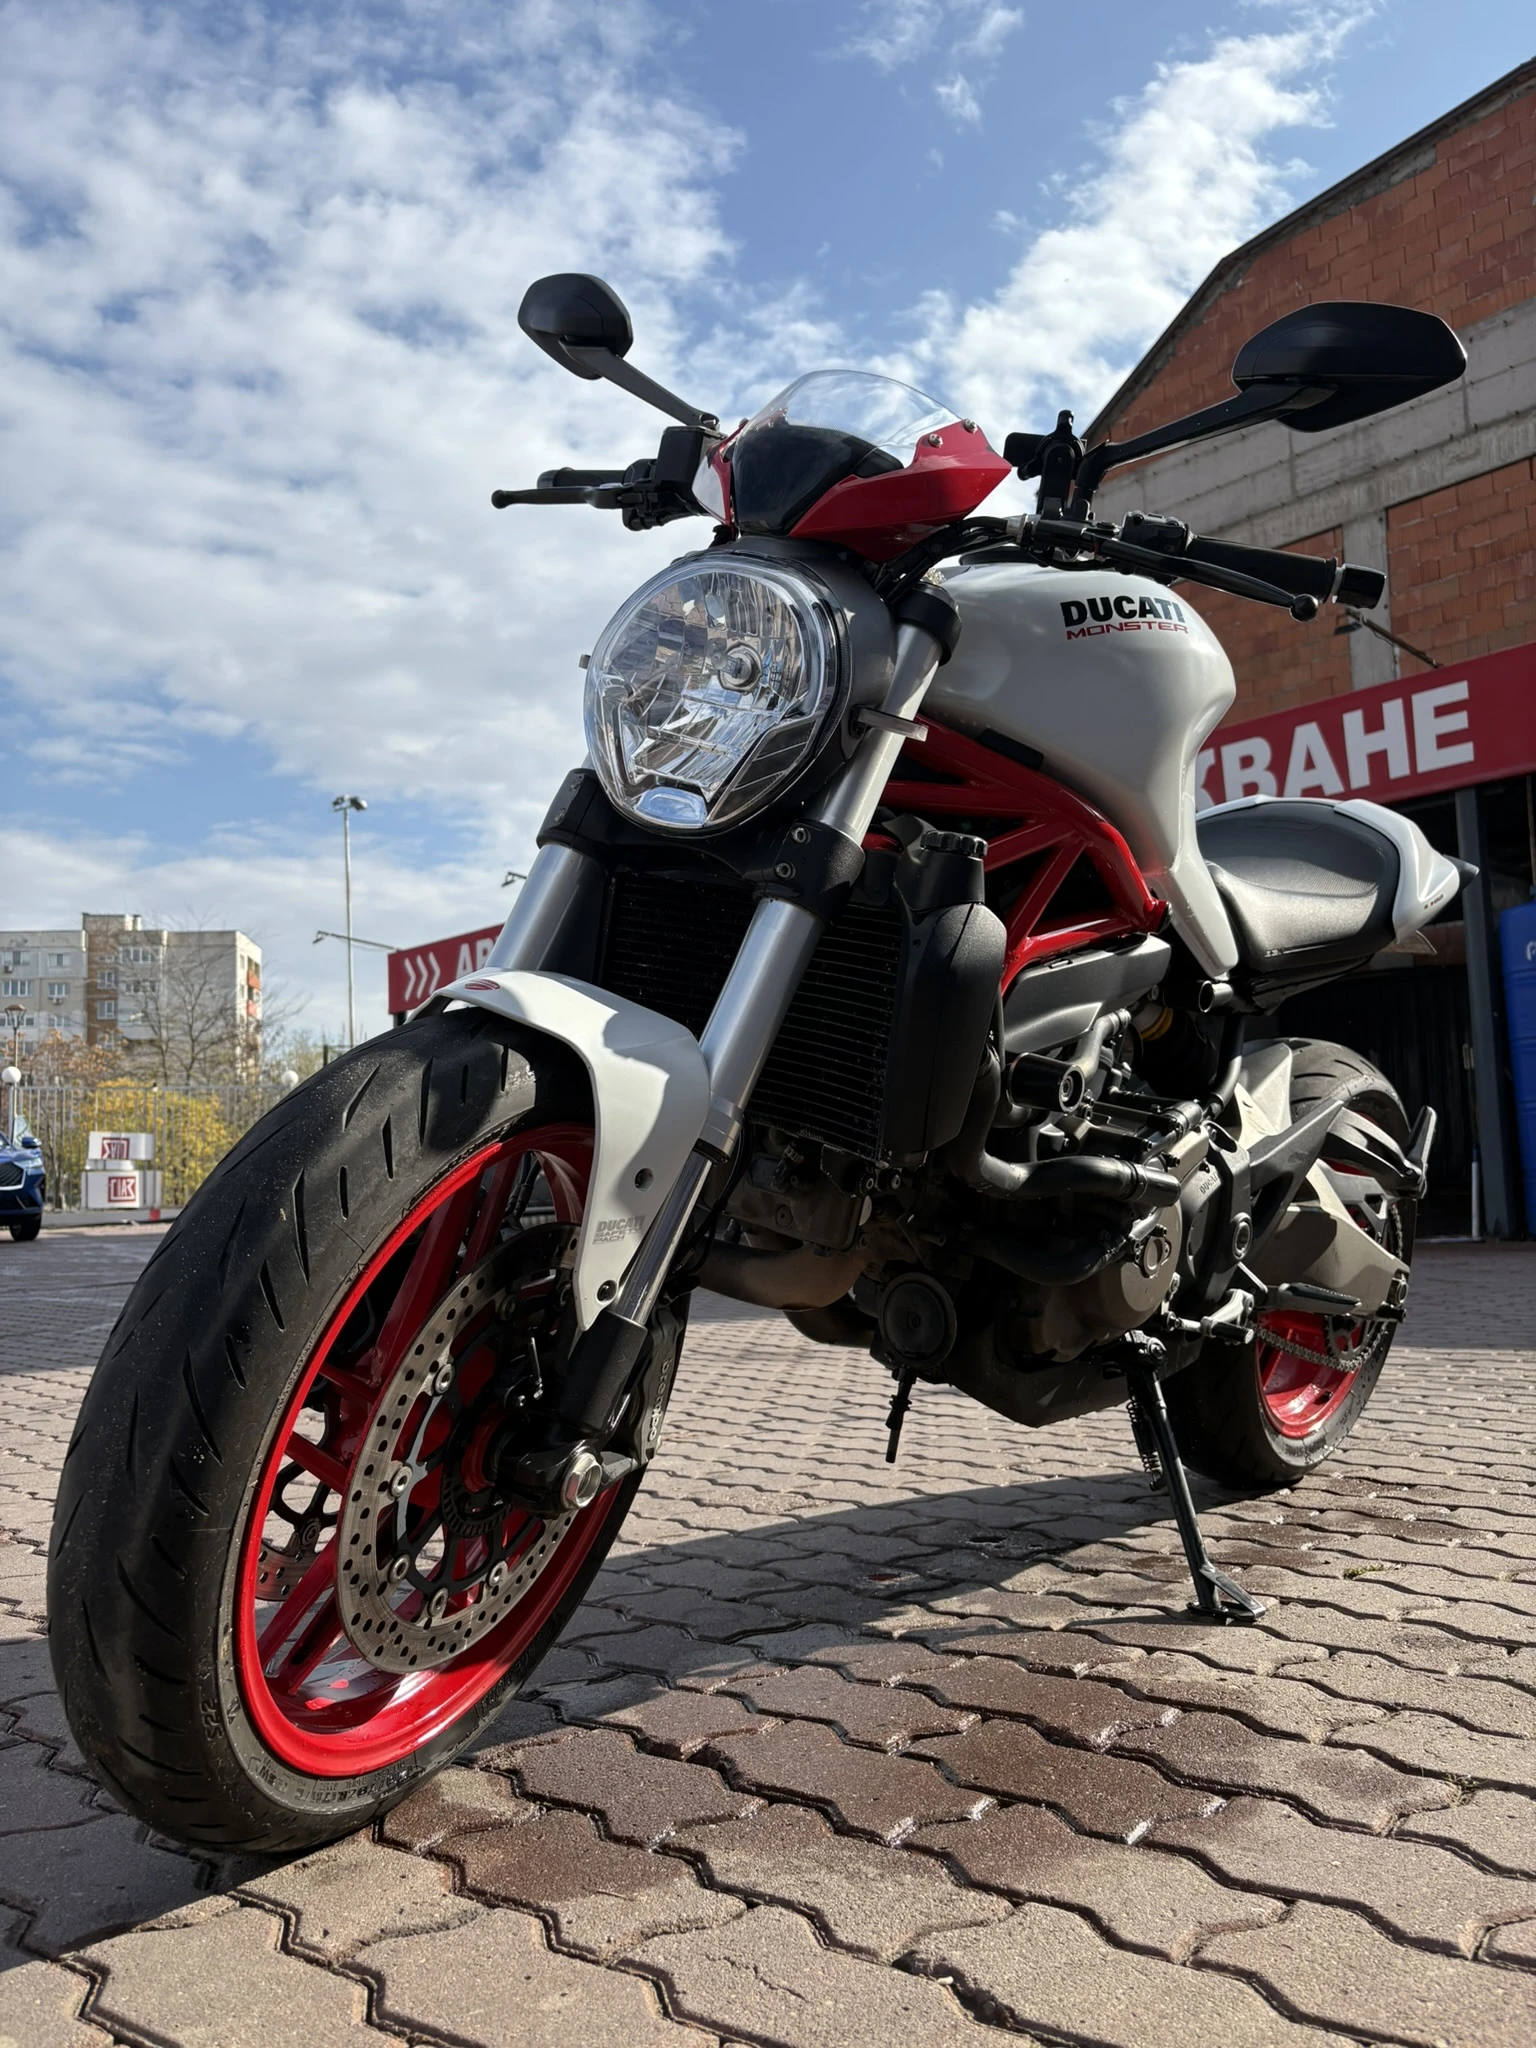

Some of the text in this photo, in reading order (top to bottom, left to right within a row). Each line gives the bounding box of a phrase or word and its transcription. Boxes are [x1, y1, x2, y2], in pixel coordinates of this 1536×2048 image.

[1060, 595, 1185, 627] DUCATI
[1066, 621, 1189, 640] MONSTER
[596, 1215, 645, 1232] DUCATI
[647, 1358, 673, 1442] brembo
